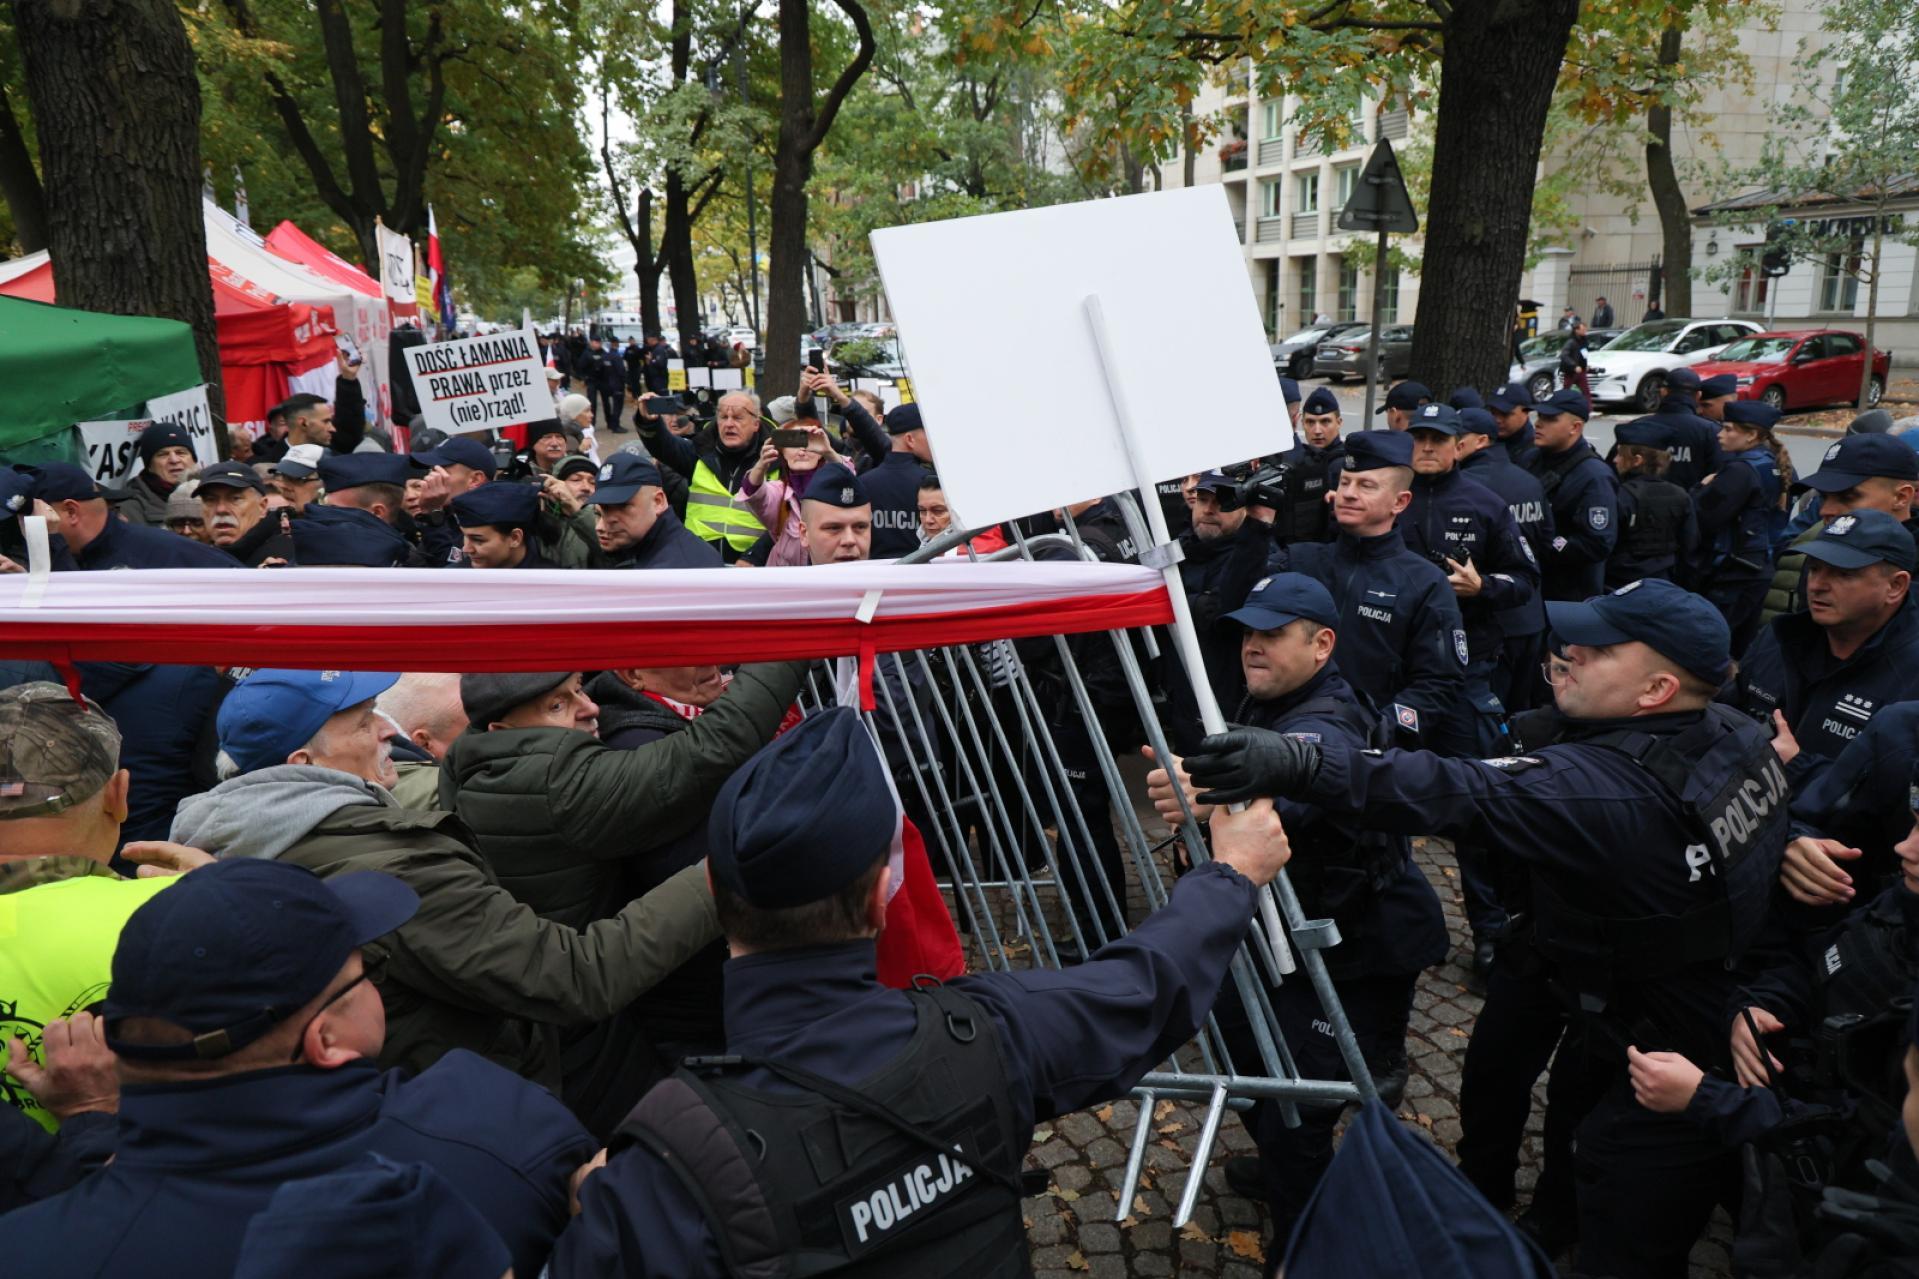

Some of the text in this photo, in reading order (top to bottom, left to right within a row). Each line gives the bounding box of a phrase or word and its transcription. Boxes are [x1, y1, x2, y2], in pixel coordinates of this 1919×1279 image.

[414, 336, 532, 375] DOŚĆ ŁAMANIA
[429, 368, 531, 400] PRAWA przez
[450, 392, 527, 427] (nie)rząd!
[872, 509, 920, 530] OLICJ
[1444, 531, 1476, 542] POLCJA
[1357, 605, 1392, 624] POLICJA
[1822, 718, 1862, 741] POLIC
[1709, 757, 1788, 859] POLICJA
[850, 1143, 974, 1243] POLICJA
